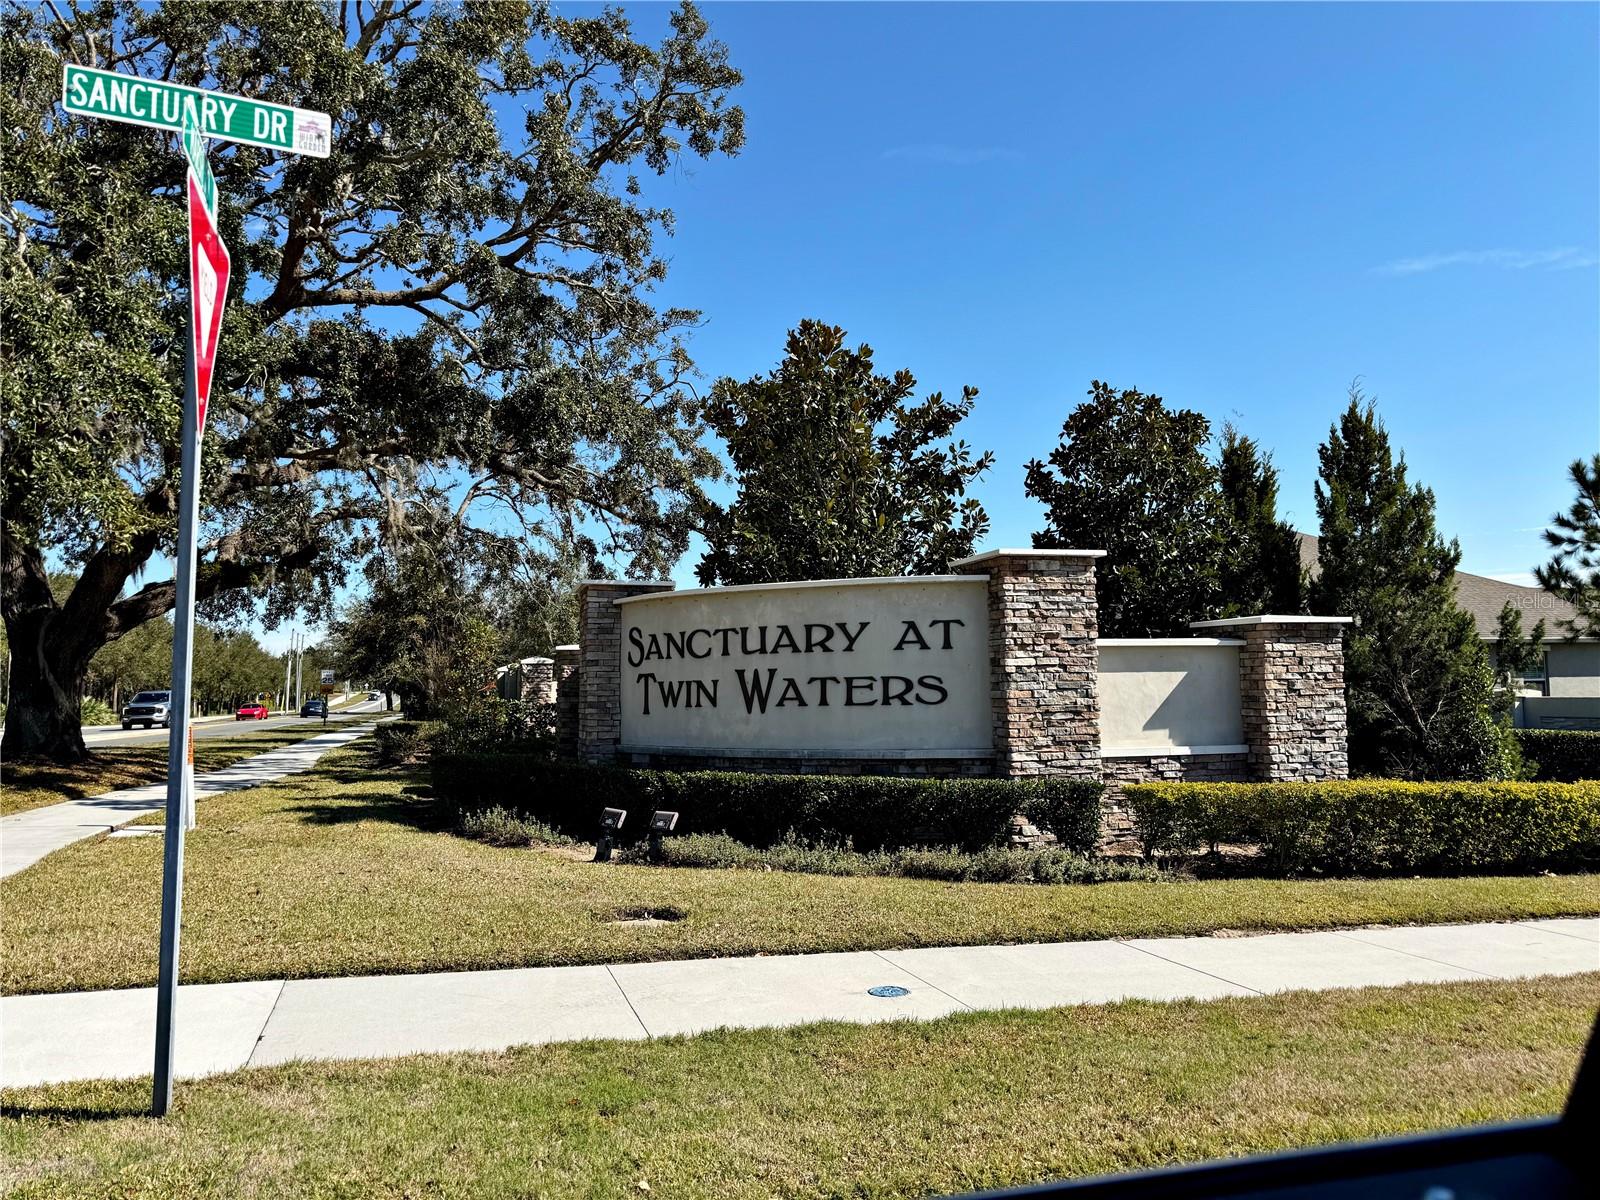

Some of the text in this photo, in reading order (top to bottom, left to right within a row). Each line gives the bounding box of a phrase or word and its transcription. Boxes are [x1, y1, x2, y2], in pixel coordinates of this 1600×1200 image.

[70, 72, 288, 144] SANCTUARY DR
[627, 619, 965, 668] SANCTUARY AT
[636, 668, 949, 715] TWIN WATERS
